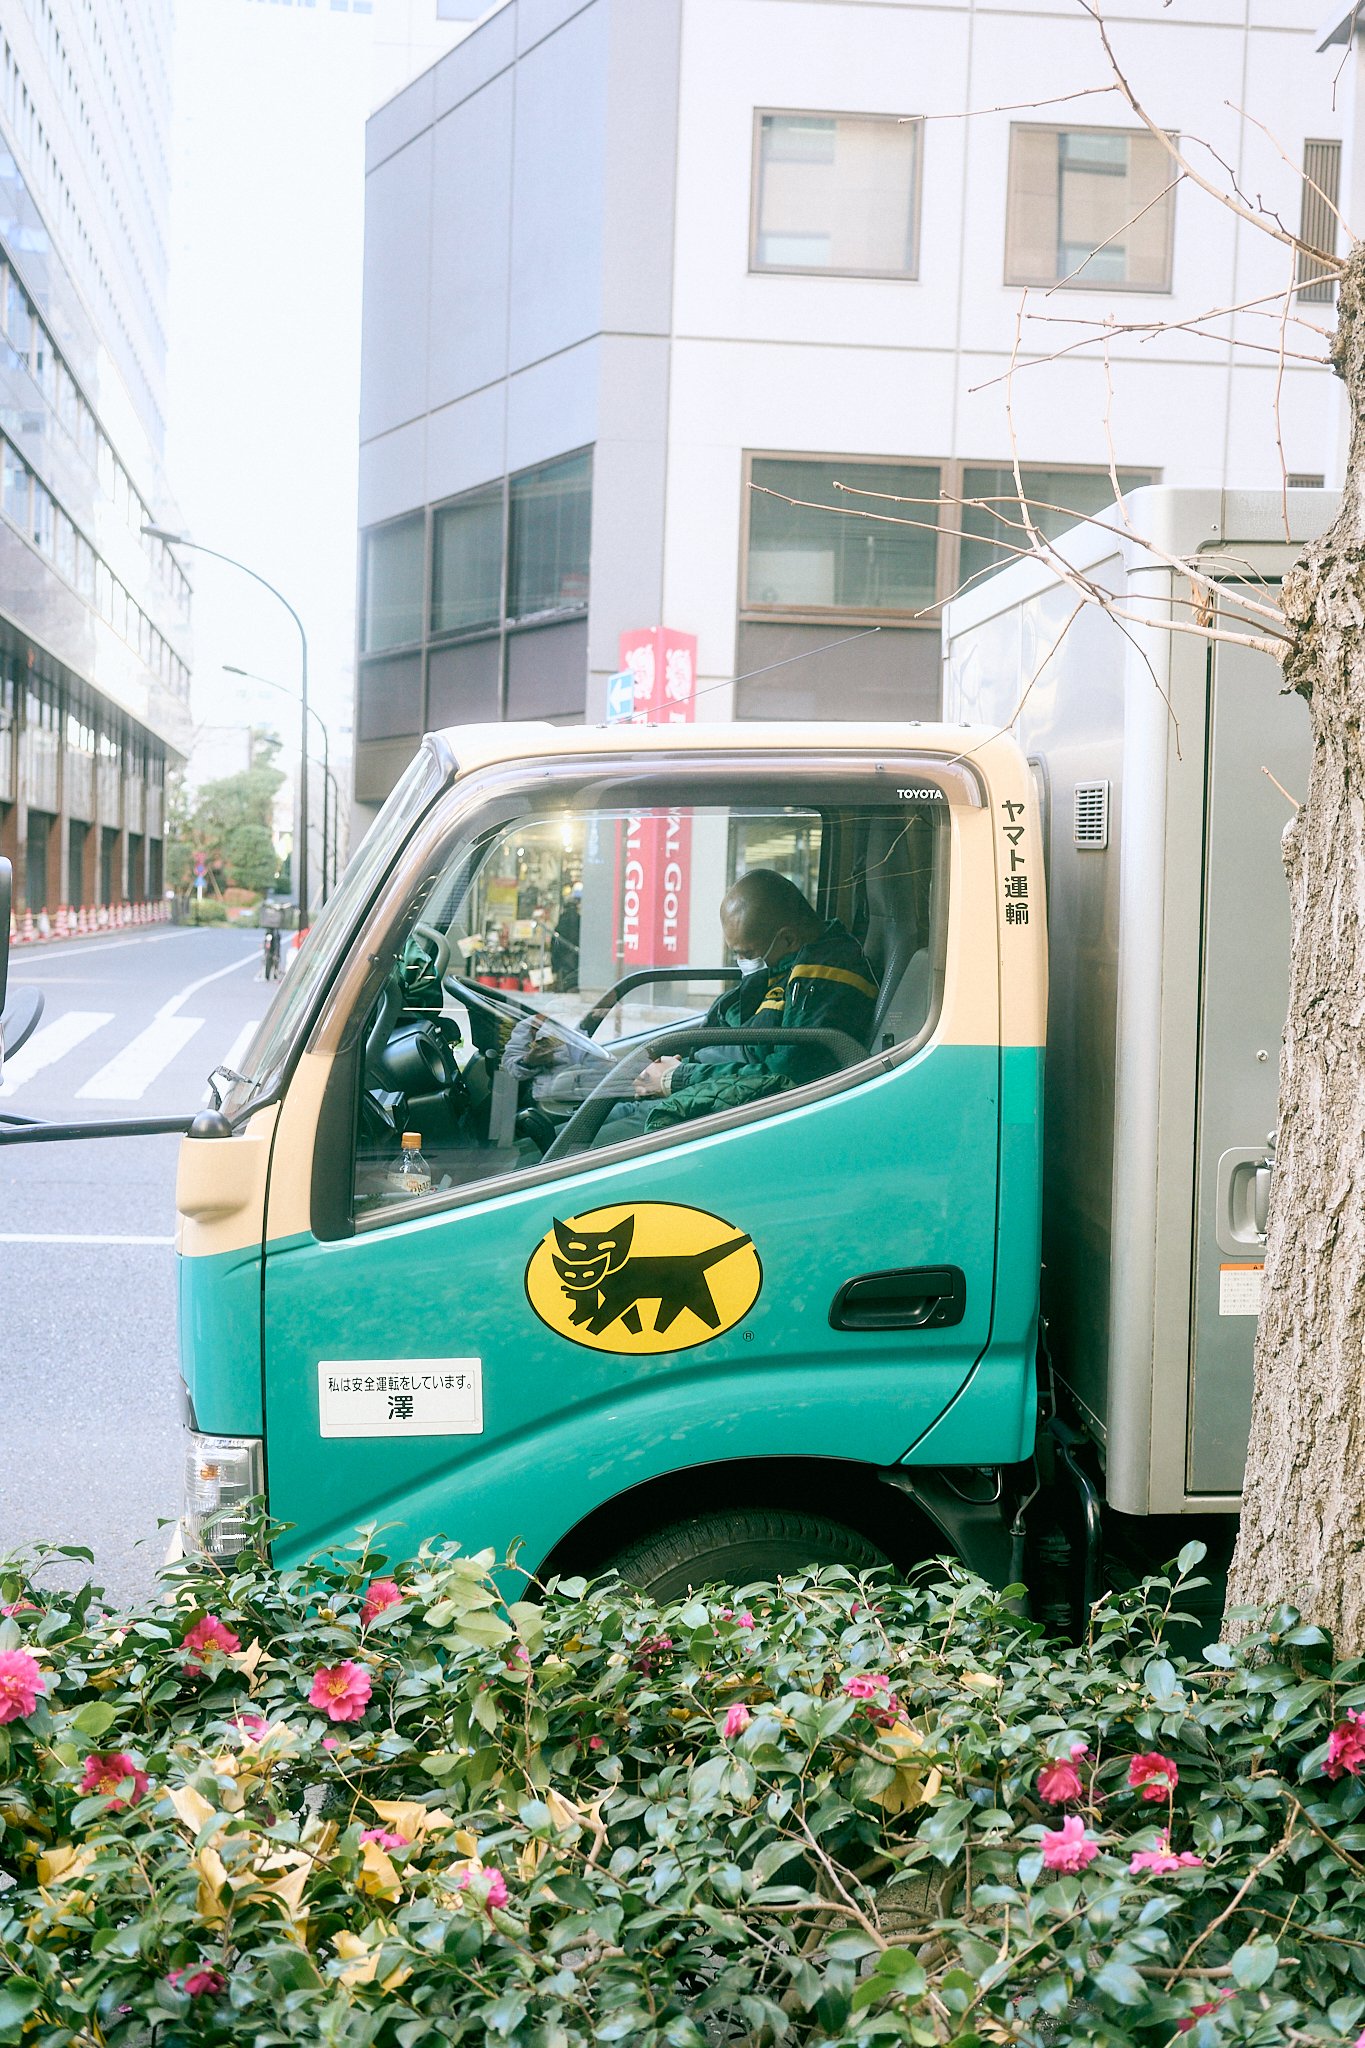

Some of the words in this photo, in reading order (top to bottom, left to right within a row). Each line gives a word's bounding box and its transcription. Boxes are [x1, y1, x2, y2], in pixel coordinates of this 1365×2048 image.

[897, 789, 943, 799] TOYOTA
[1001, 799, 1029, 925] ヤマト運輸
[624, 860, 644, 951] GOLF
[663, 862, 682, 953] GOLF
[328, 1375, 472, 1393] 私は安全運転をしています。
[387, 1395, 414, 1420] 澤
